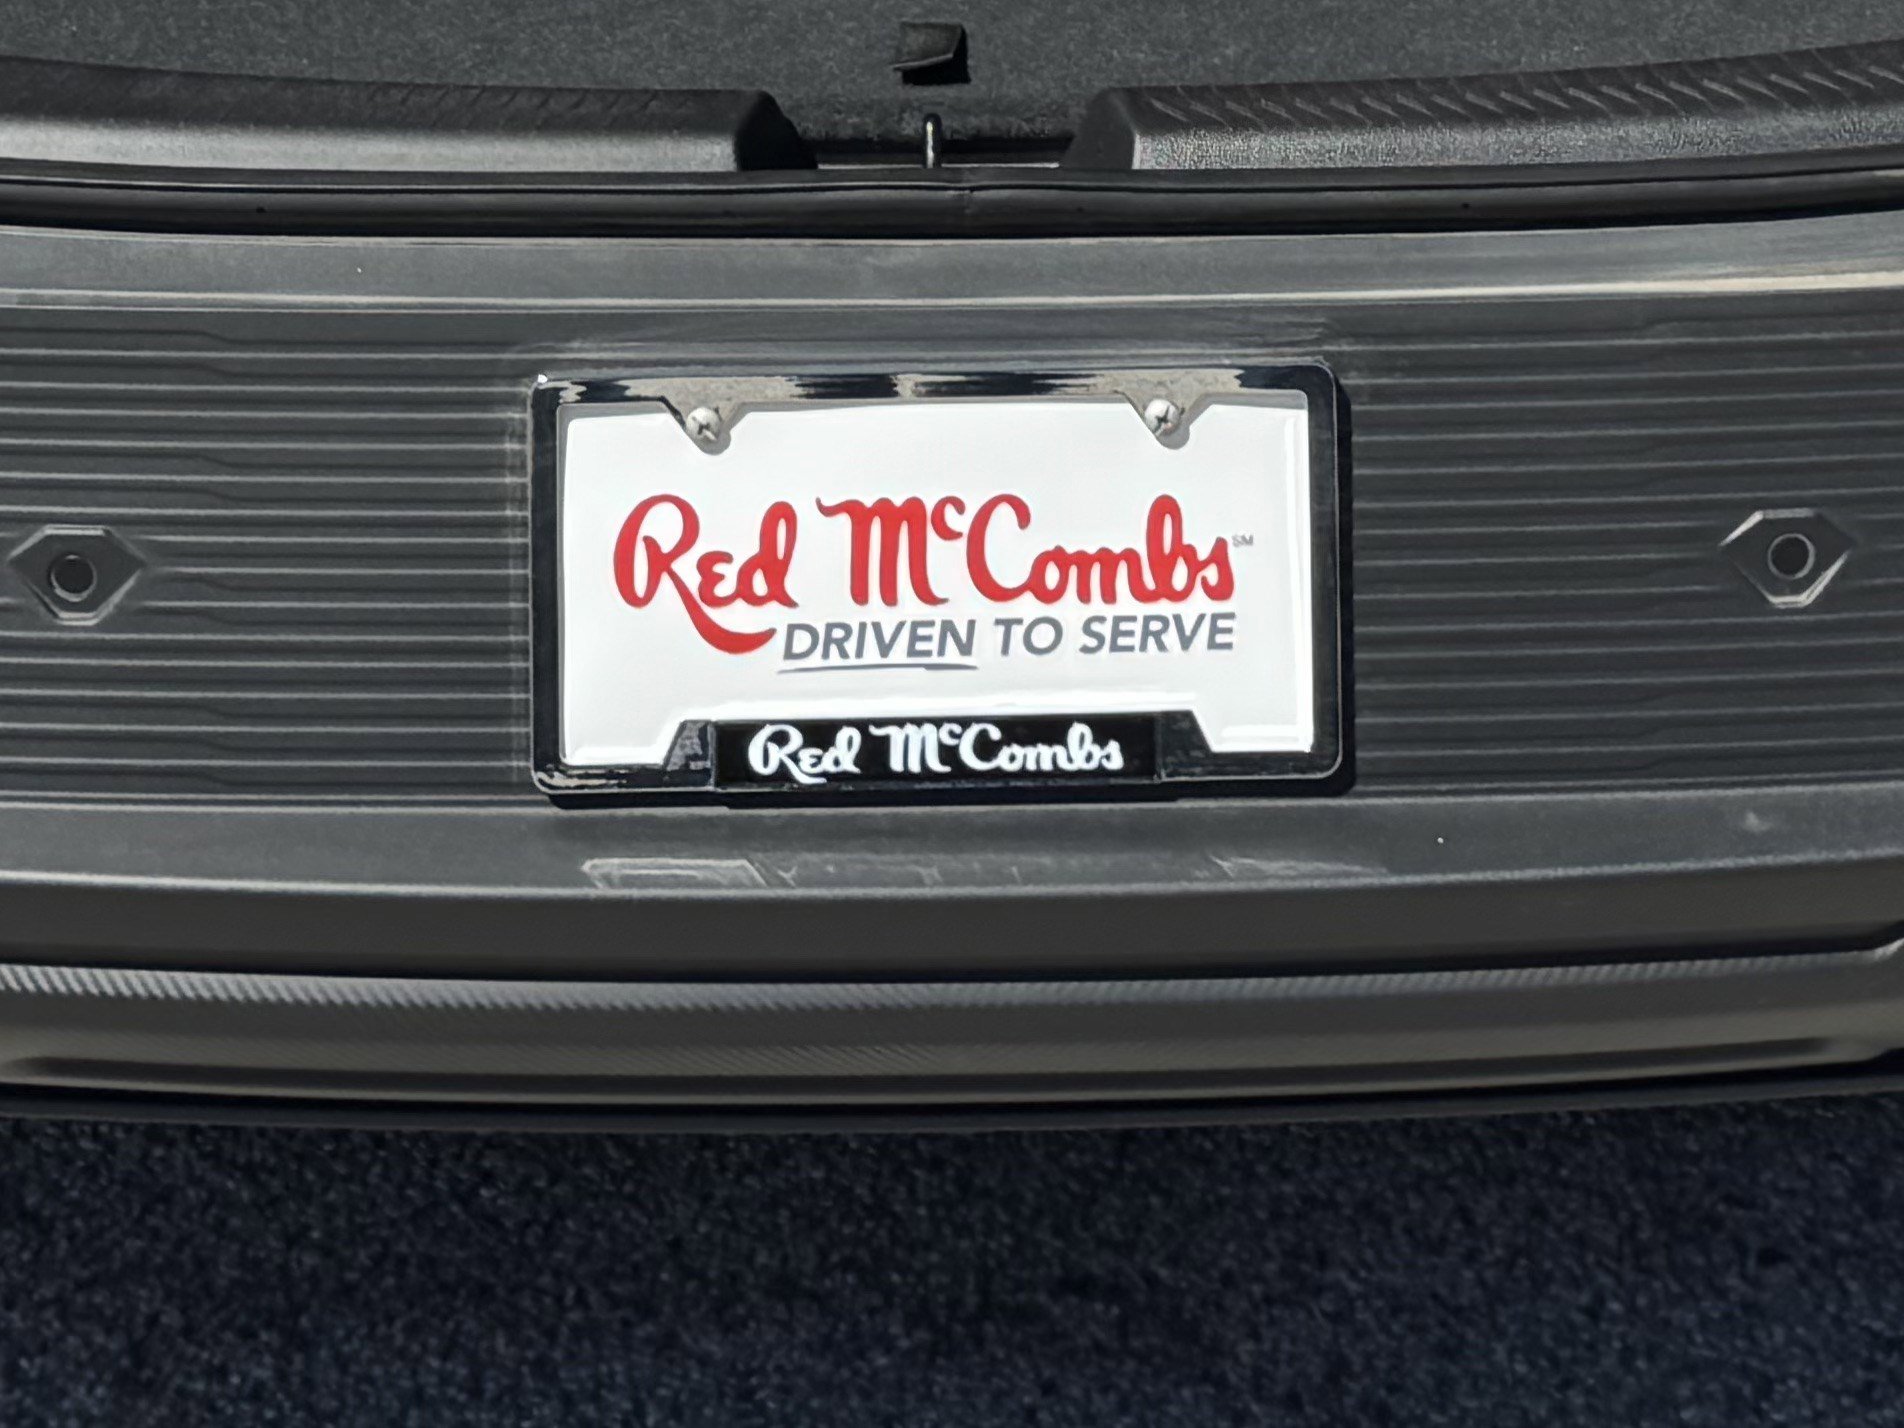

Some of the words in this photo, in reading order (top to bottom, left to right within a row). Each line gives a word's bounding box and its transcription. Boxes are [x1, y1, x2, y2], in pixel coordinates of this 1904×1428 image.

[613, 494, 798, 655] Red
[817, 494, 1235, 606] McCombs
[782, 618, 977, 661] DRIVEN
[993, 616, 1064, 657] TO
[1078, 611, 1236, 655] SERVE
[747, 723, 863, 784] Red
[868, 721, 1125, 774] McCombs
